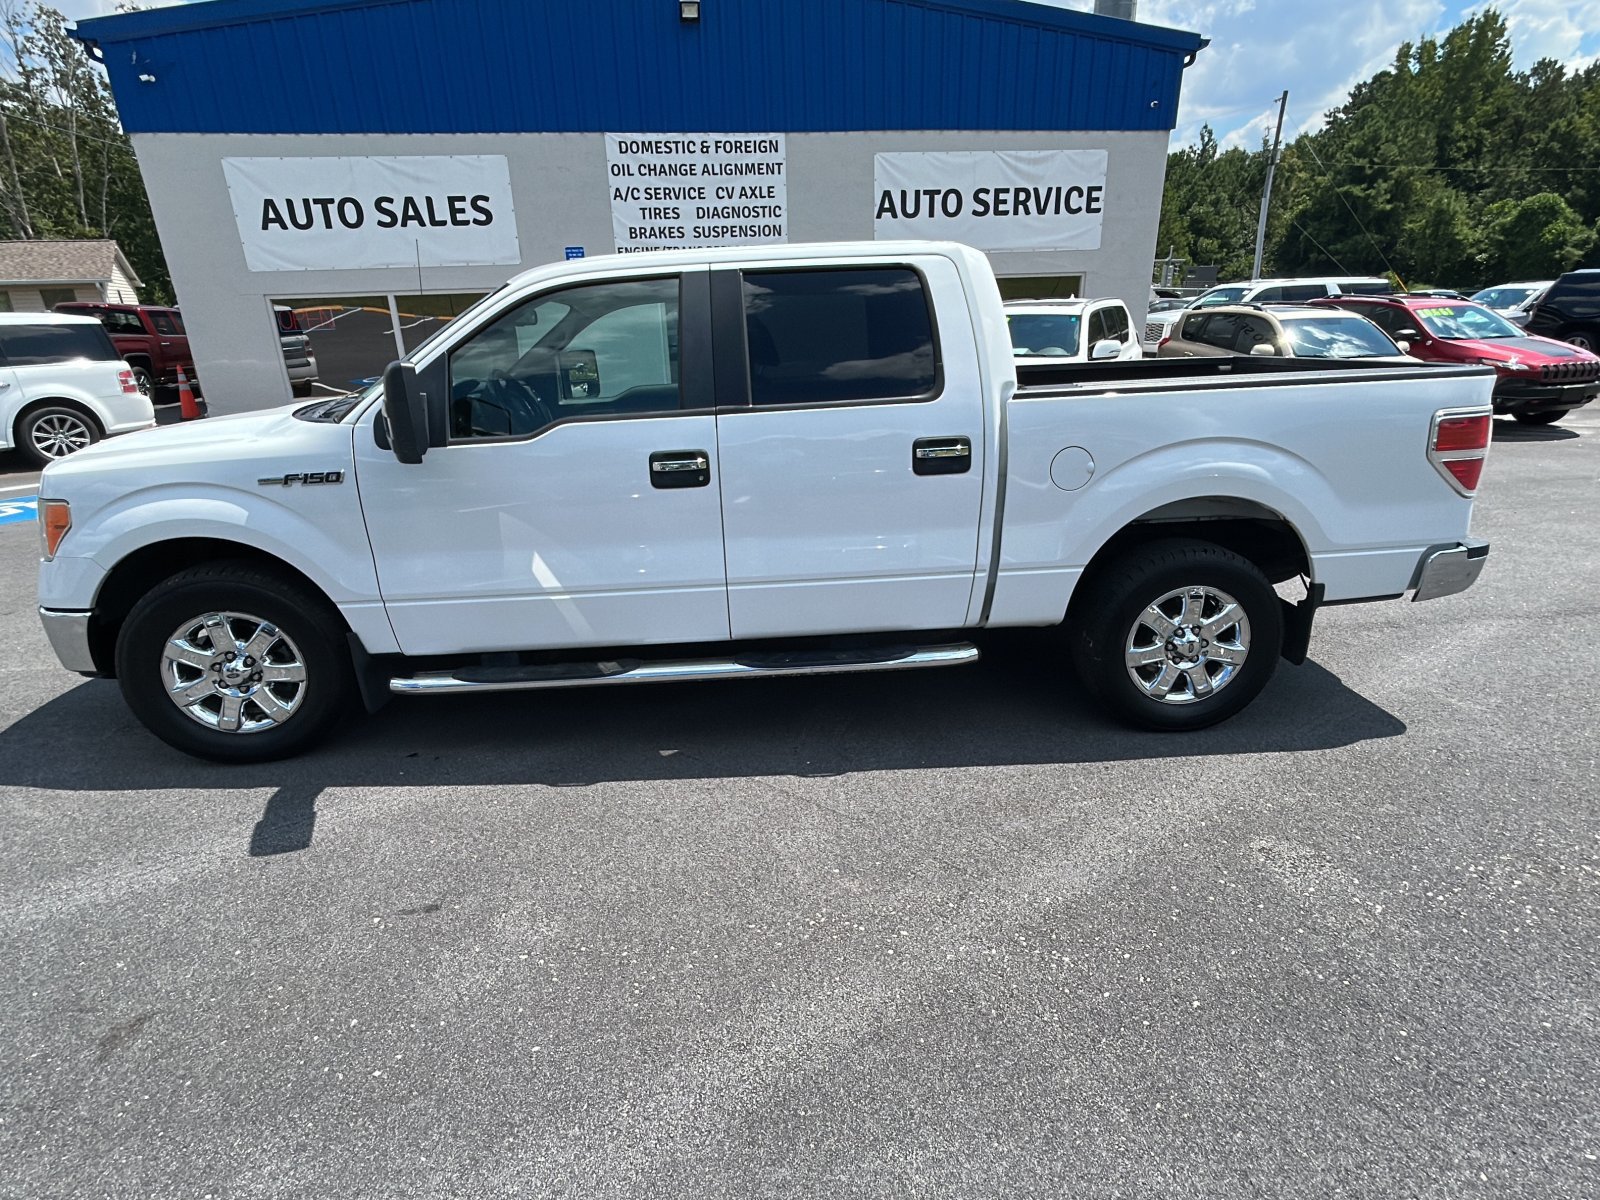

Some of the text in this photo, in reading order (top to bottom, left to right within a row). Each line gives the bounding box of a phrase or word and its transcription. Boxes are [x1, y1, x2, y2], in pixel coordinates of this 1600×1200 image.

[619, 140, 779, 154] DOMESTIC & FOREIGN
[611, 162, 783, 177] OIL CHANGE ALIGNMENT
[613, 185, 776, 203] A/C SERVICE CV AXLE
[875, 185, 1103, 220] AUTO SERVICE
[261, 194, 494, 231] AUTO SALES
[639, 205, 782, 220] TIRES DIAGNOSTIC
[629, 224, 782, 240] BRAKES SUSPENSION
